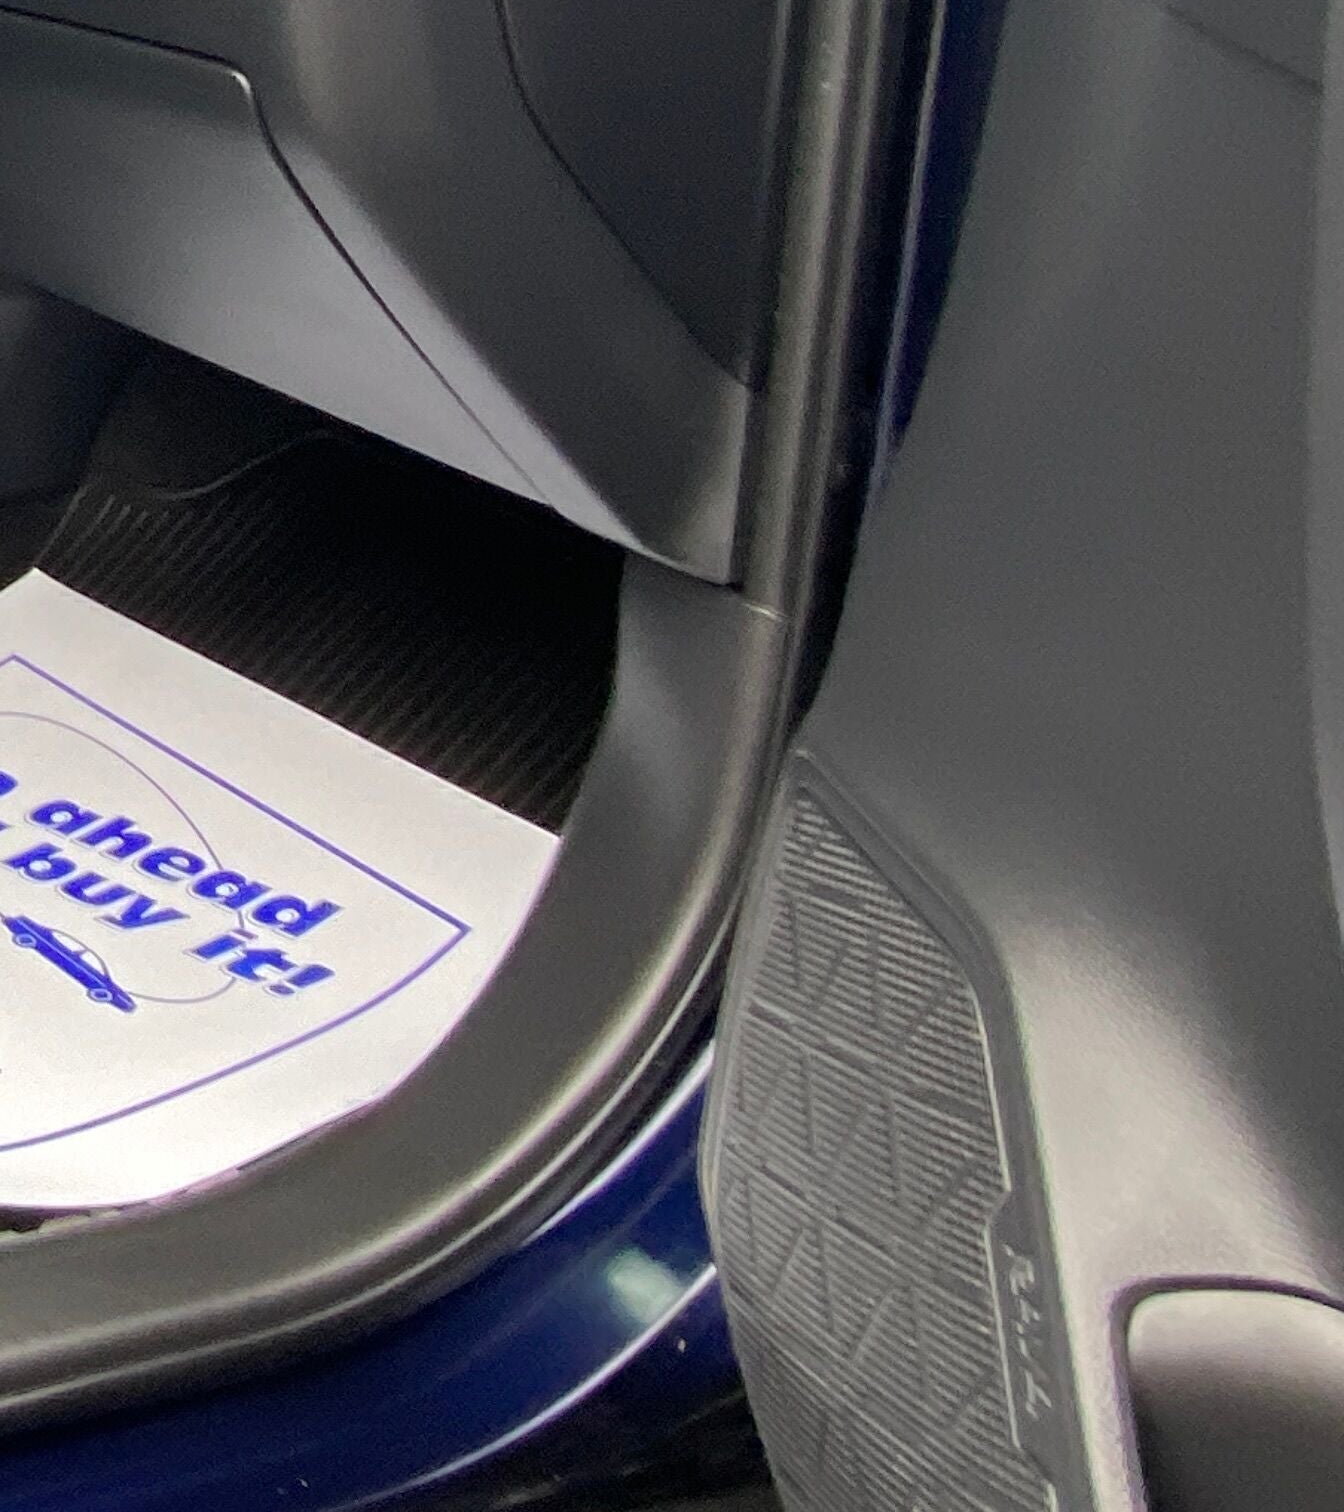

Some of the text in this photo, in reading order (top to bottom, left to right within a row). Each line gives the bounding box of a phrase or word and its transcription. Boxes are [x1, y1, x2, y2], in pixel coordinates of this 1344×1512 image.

[2, 841, 188, 931] buy
[188, 929, 336, 997] it!
[29, 799, 340, 937] ahead
